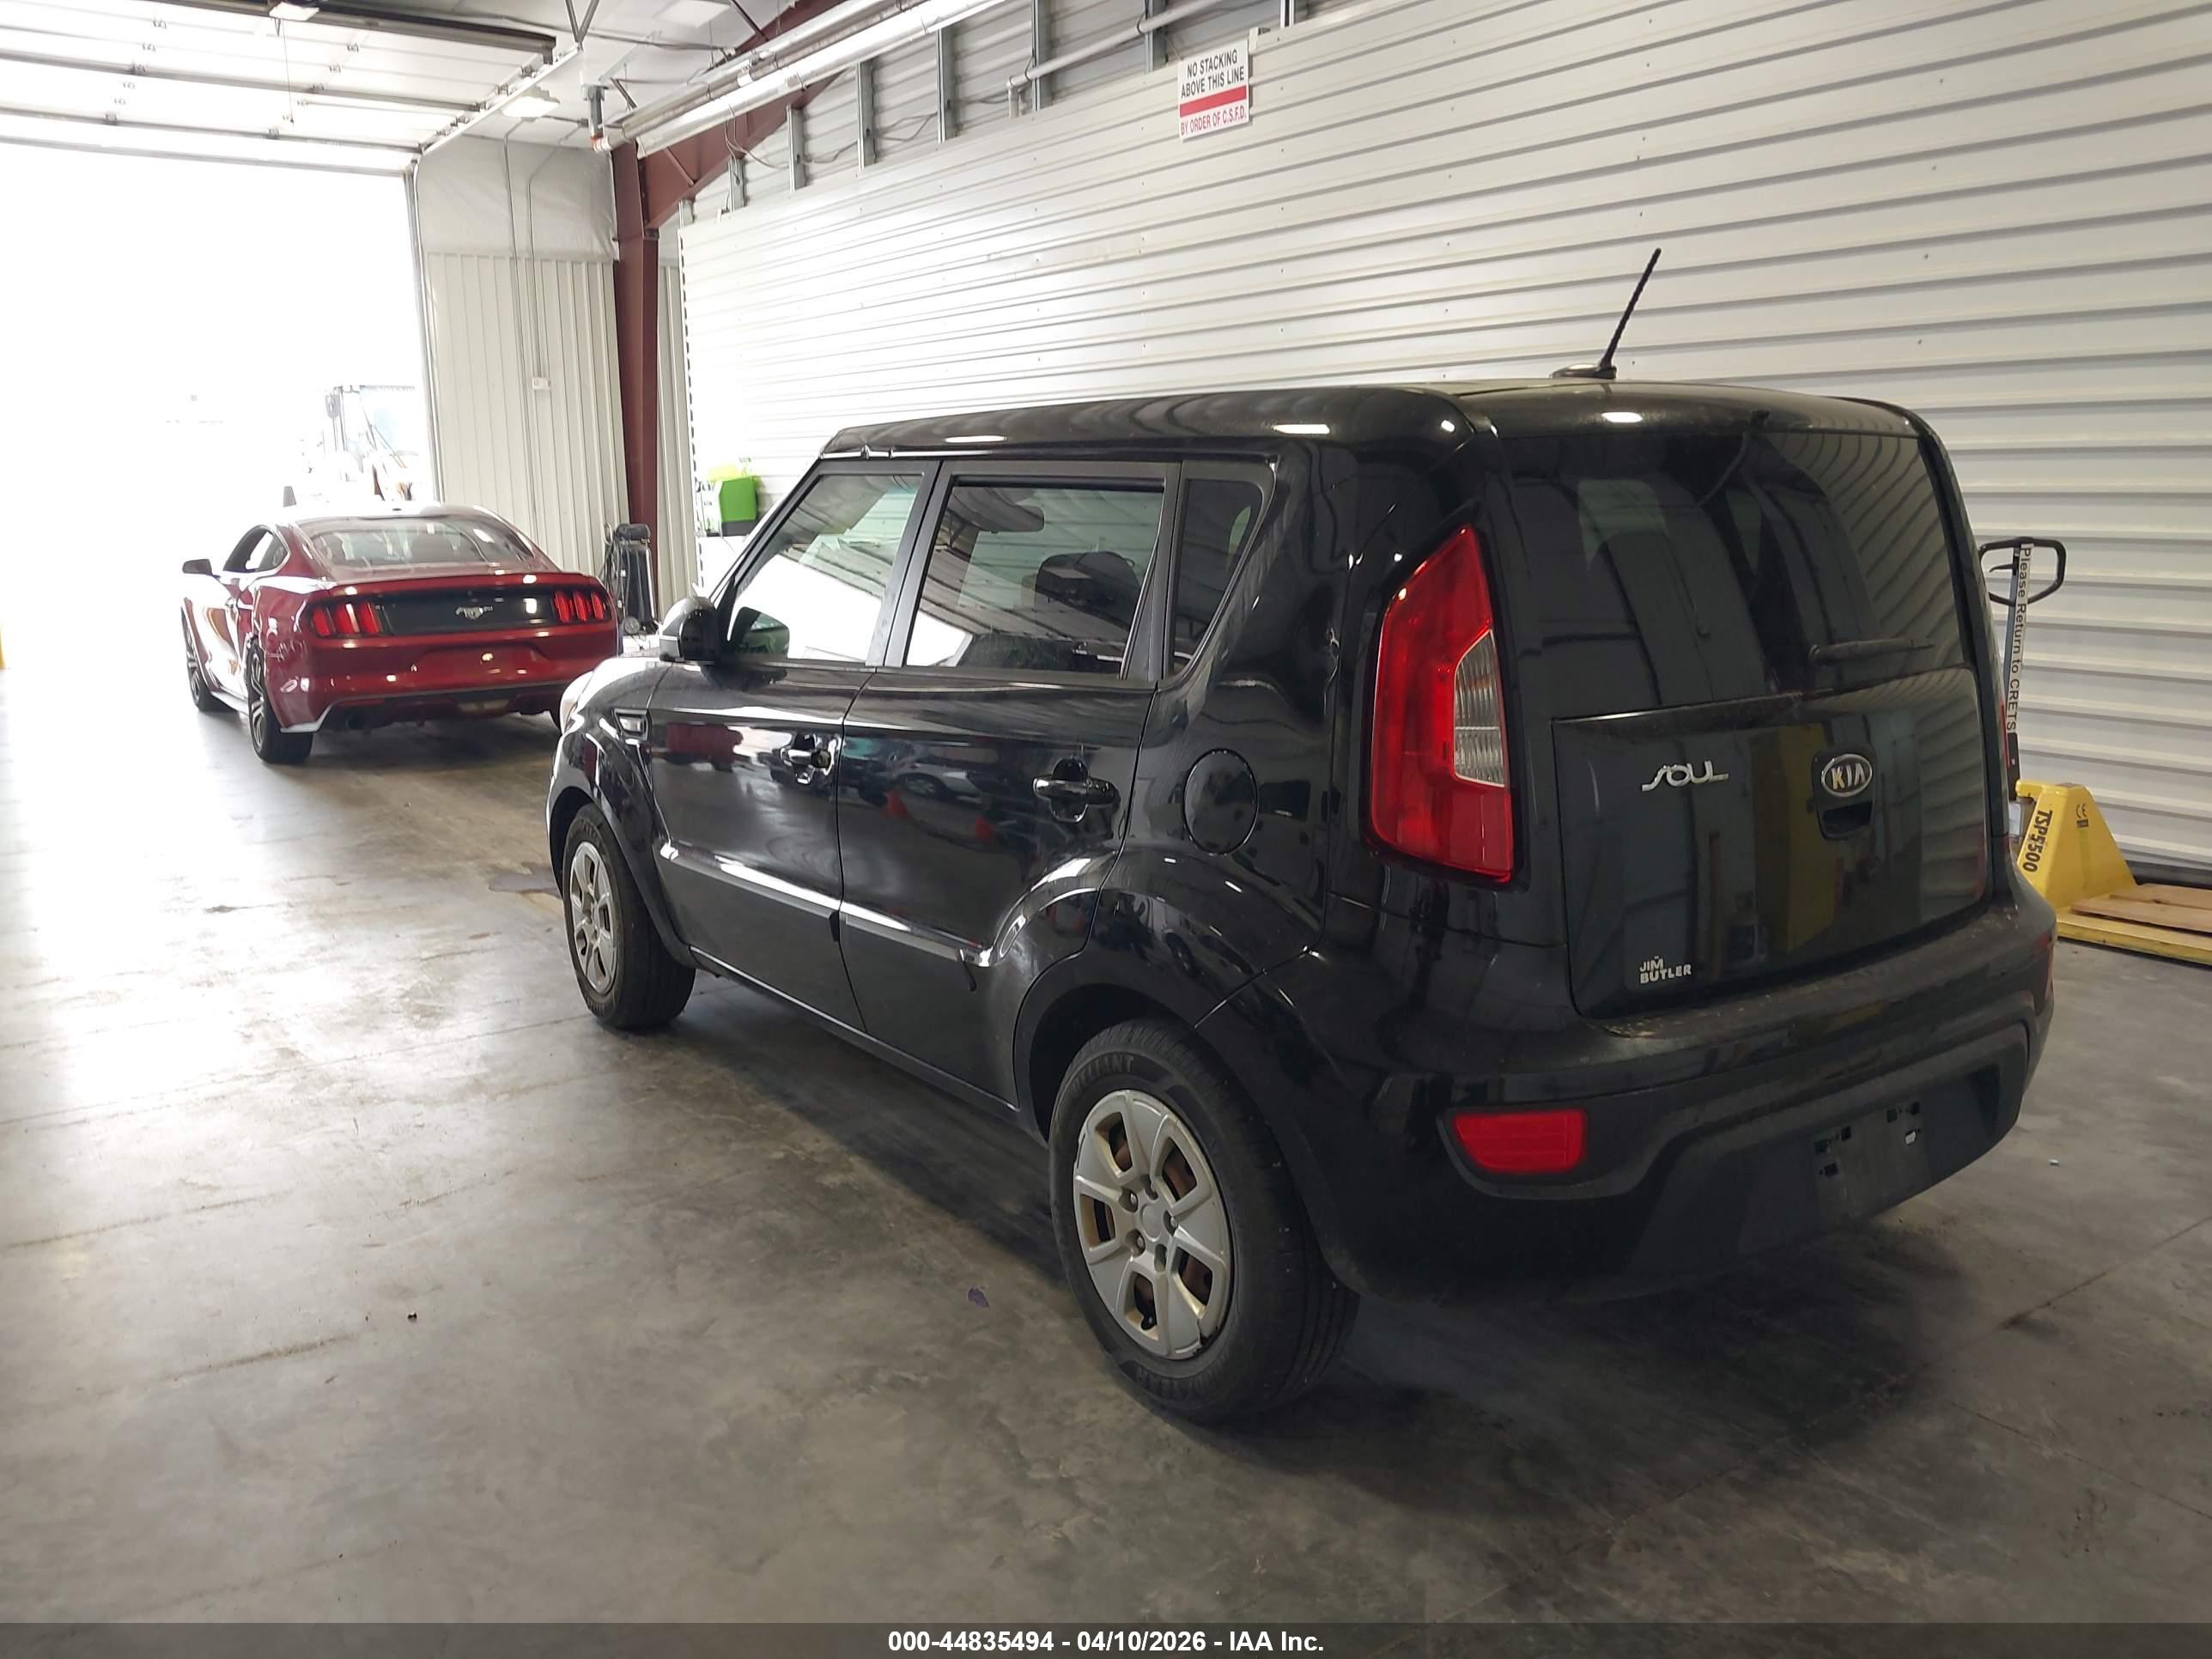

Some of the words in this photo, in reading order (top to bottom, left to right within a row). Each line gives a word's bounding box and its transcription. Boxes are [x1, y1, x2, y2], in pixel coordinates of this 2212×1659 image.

[1187, 62, 1198, 77] NO
[1200, 49, 1237, 75] STACKING
[1181, 78, 1206, 99] ABOVE
[1207, 73, 1225, 90] THIS
[1227, 66, 1244, 84] LINE
[1181, 120, 1188, 135] BY
[1190, 115, 1211, 132] ORDER
[1212, 112, 1221, 126] OF
[1222, 106, 1247, 125] C.S.F.D.
[2018, 547, 2033, 601] Please
[2012, 604, 2027, 654] Return
[2010, 659, 2021, 673] to
[2006, 678, 2021, 731] CRETS
[1641, 760, 1729, 792] SOUL
[1830, 761, 1867, 792] KIA
[2022, 810, 2053, 872] TSP5500
[1639, 957, 1664, 972] JIM
[1640, 963, 1692, 984] BUTLER
